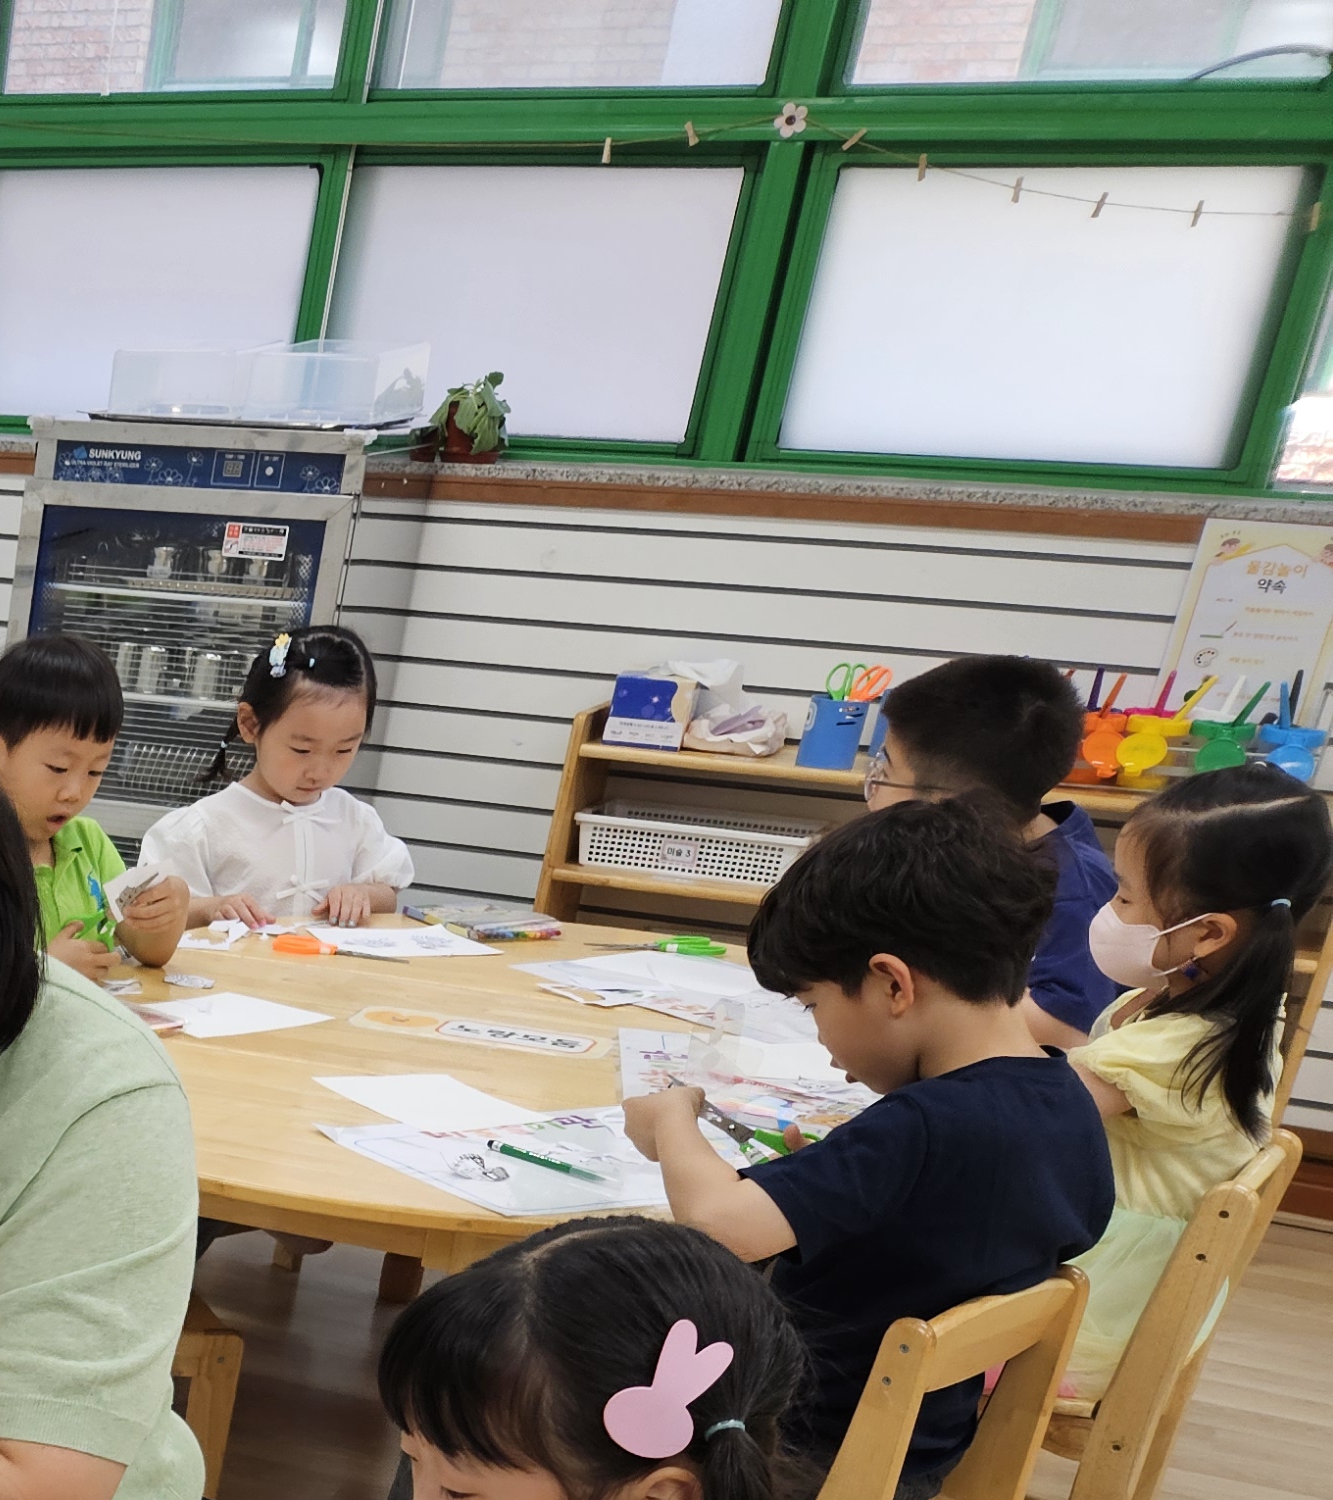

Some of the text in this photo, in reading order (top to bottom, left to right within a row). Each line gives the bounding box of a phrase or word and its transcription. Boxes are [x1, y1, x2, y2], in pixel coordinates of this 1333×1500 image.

[88, 447, 142, 461] SUNKYUNG
[1246, 560, 1309, 579] 물감놀이
[1257, 578, 1287, 594] 약속
[685, 849, 691, 858] 3
